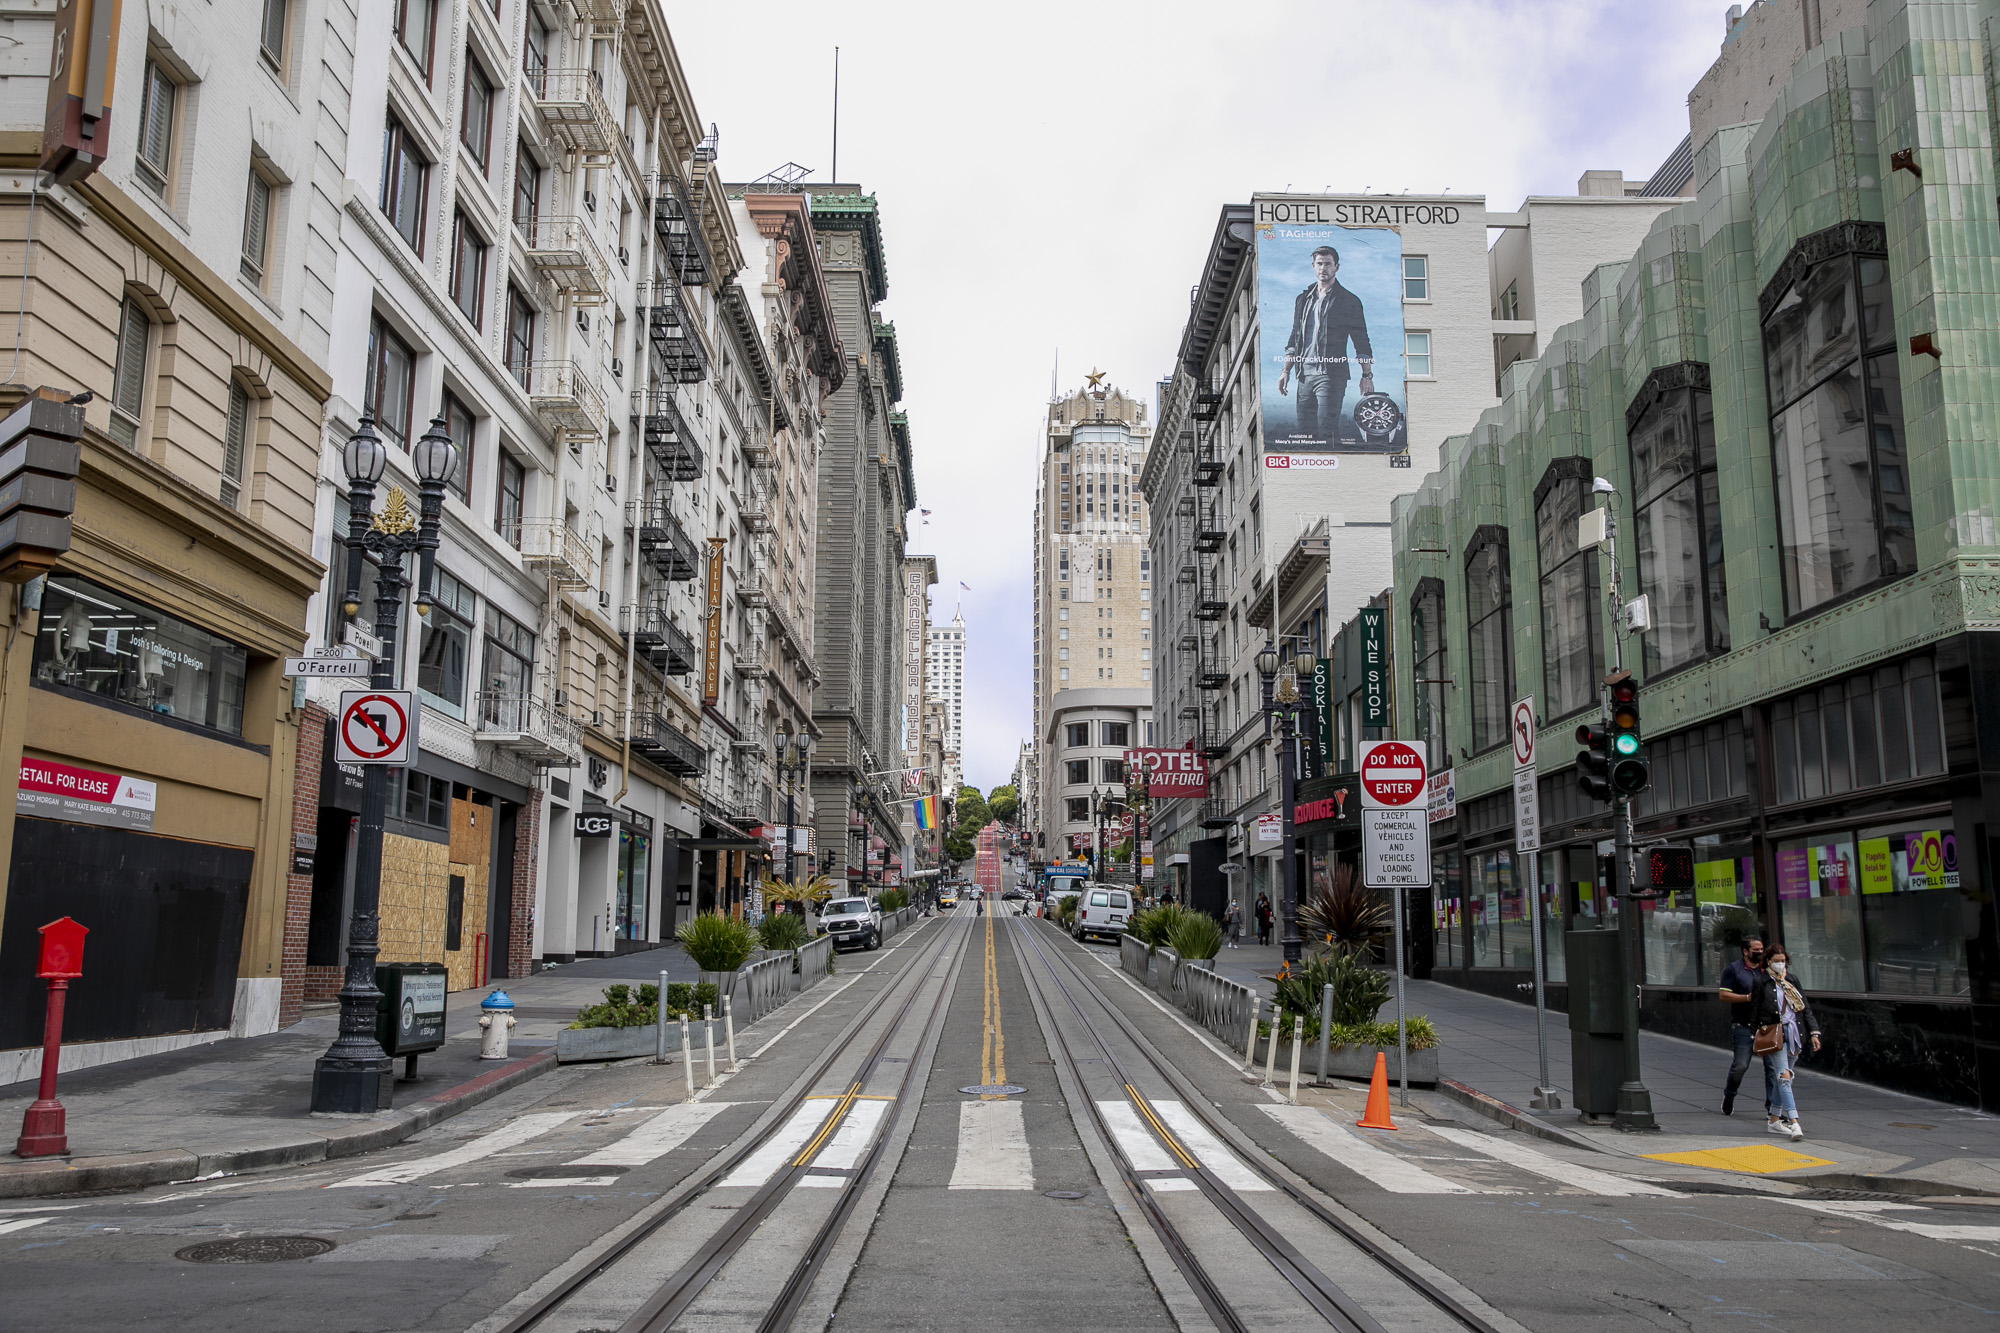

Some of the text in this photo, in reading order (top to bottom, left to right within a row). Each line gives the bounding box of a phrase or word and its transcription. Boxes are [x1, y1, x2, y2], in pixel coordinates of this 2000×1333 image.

[1260, 203, 1460, 225] HOTEL STRATFORD
[1268, 457, 1288, 467] BIG
[709, 546, 726, 602] VILLA
[908, 573, 921, 687] CHANCELLOR
[1365, 615, 1378, 663] WINE
[354, 632, 374, 651] Powell
[706, 604, 721, 692] FLORENCE
[130, 634, 150, 650] Josh's
[151, 642, 176, 662] Tailoring
[178, 652, 182, 662] &
[184, 654, 204, 670] Design
[298, 662, 357, 674] O'Farrell
[1368, 670, 1380, 719] SHOP
[1314, 664, 1326, 755] COCKTAILS
[908, 694, 919, 752] HOTEL
[1128, 752, 1204, 770] HOTEL
[1370, 755, 1416, 765] DO NOT
[589, 757, 607, 790] UGG
[1130, 772, 1204, 786] STRATFORD
[1434, 772, 1449, 790] LEASE
[56, 774, 75, 789] FOR
[78, 778, 109, 794] LEASE
[1376, 783, 1412, 794] ENTER
[36, 795, 59, 805] MORGAN
[64, 800, 77, 808] MARY
[78, 802, 89, 811] KATE
[90, 803, 117, 814] BANCHERO
[122, 810, 130, 818] 415
[576, 818, 609, 833] UGG
[1866, 852, 1885, 862] Flagship
[1910, 835, 1958, 873] 200
[1819, 863, 1844, 878] CBRE
[1712, 879, 1720, 888] 772
[1912, 875, 1959, 887] POWELL STREE
